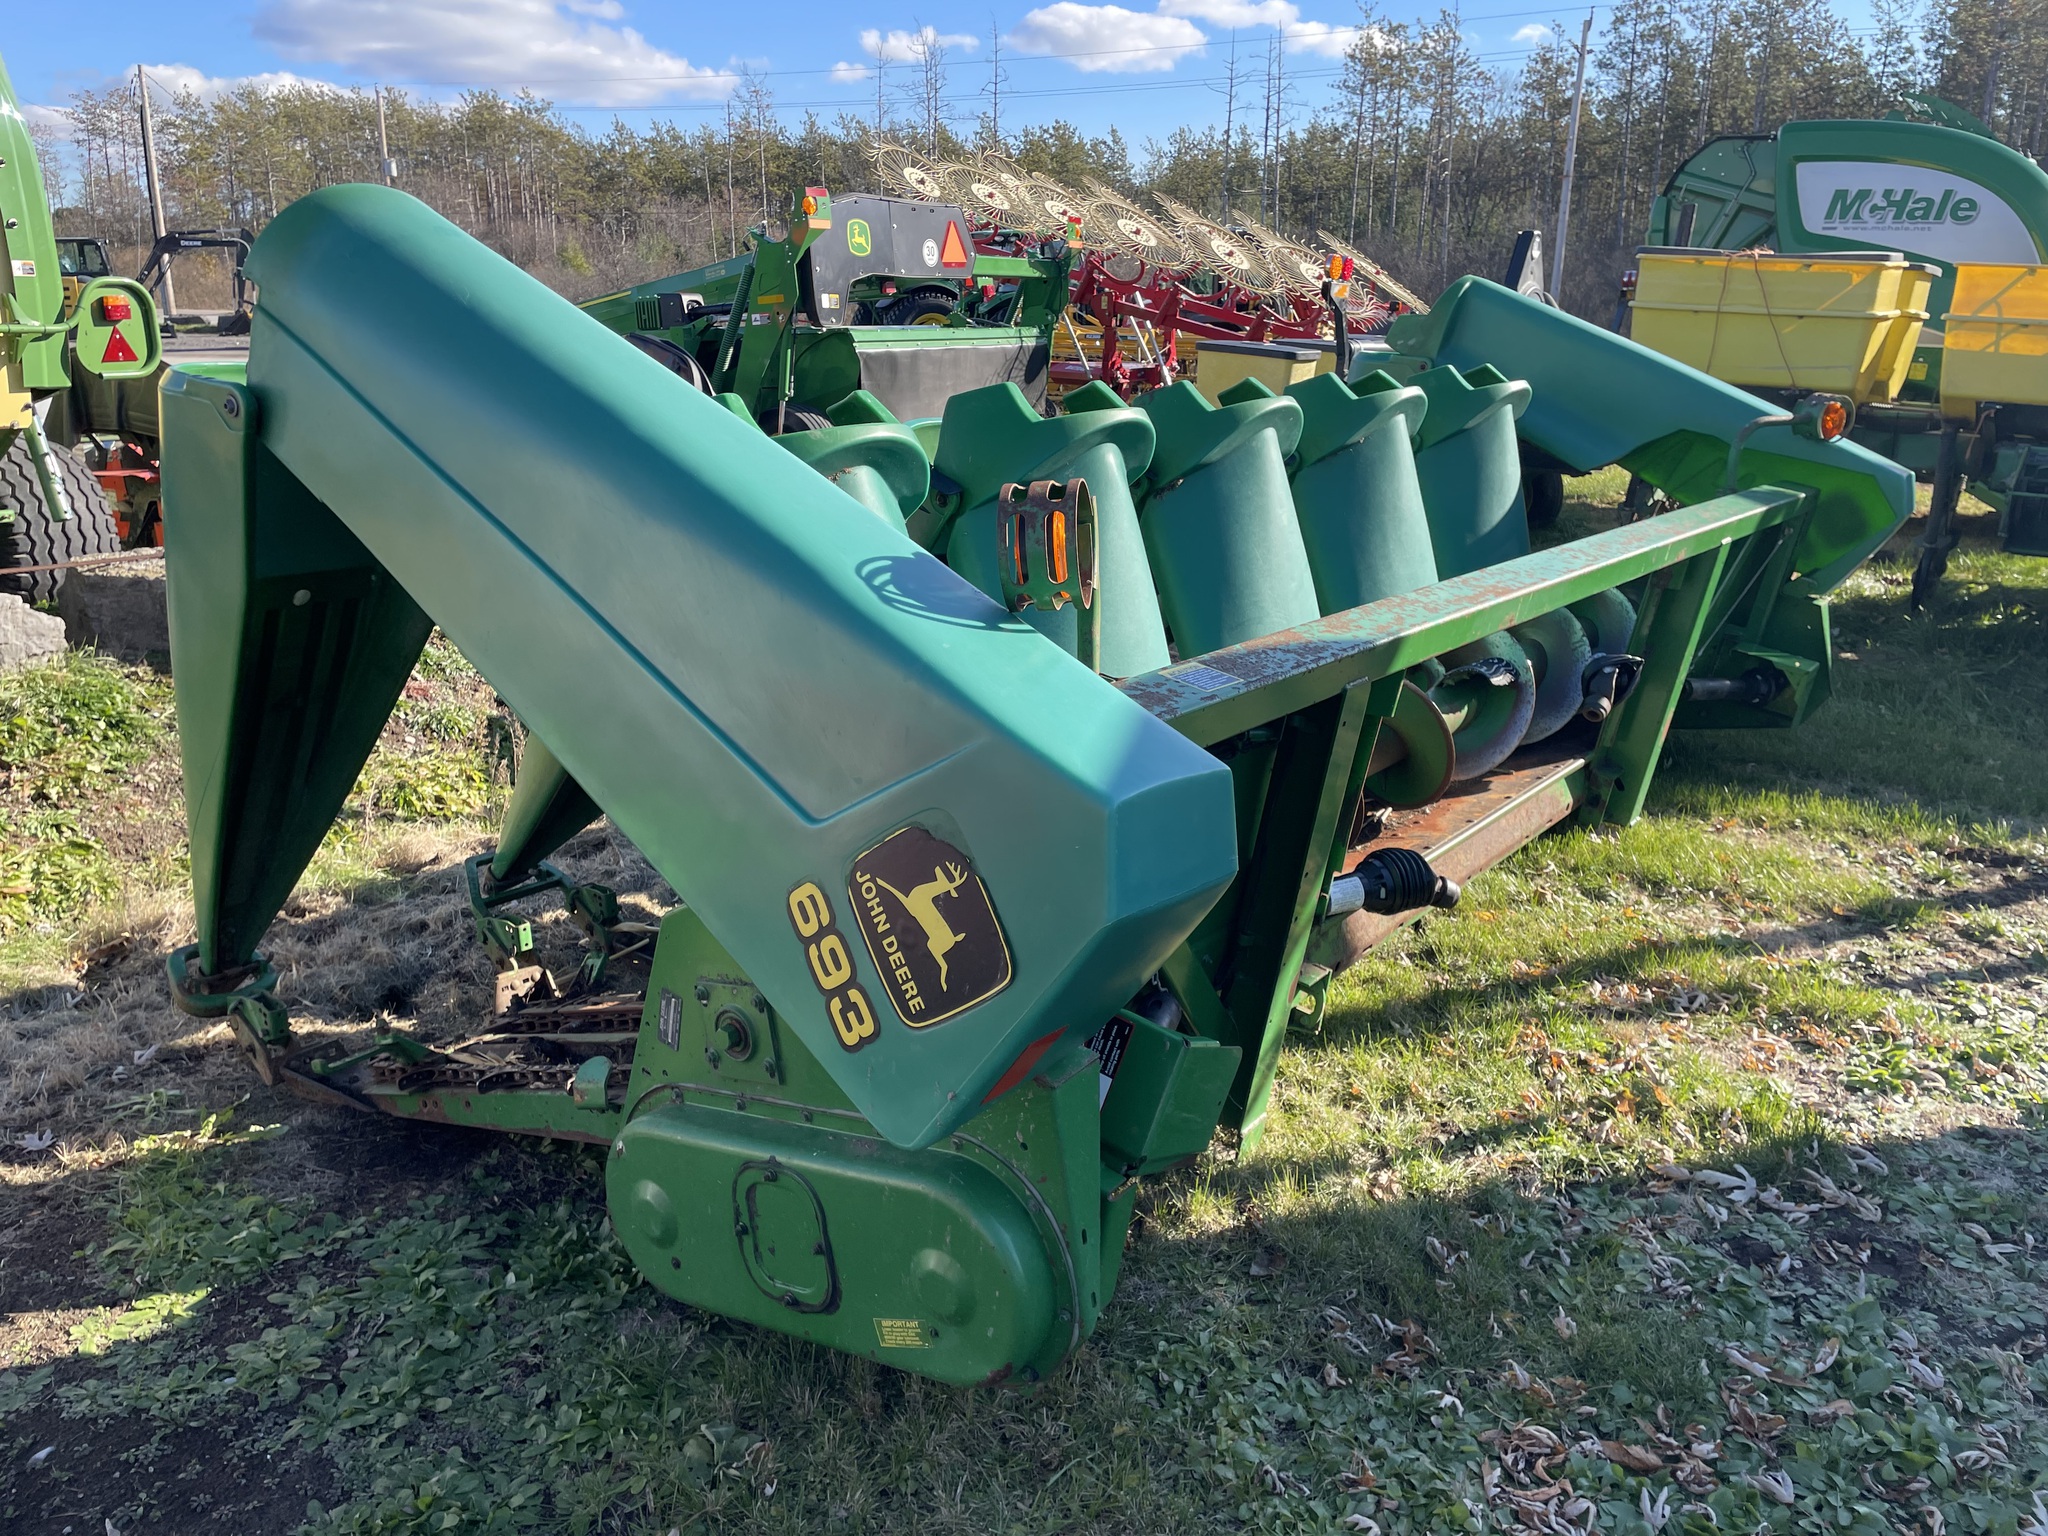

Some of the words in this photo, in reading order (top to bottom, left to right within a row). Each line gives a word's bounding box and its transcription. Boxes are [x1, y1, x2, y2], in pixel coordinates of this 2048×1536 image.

[926, 245, 935, 256] 30
[1824, 189, 1979, 223] McHale
[789, 882, 875, 1046] 693
[856, 871, 890, 933] JOHN
[882, 935, 925, 1015] DEERE
